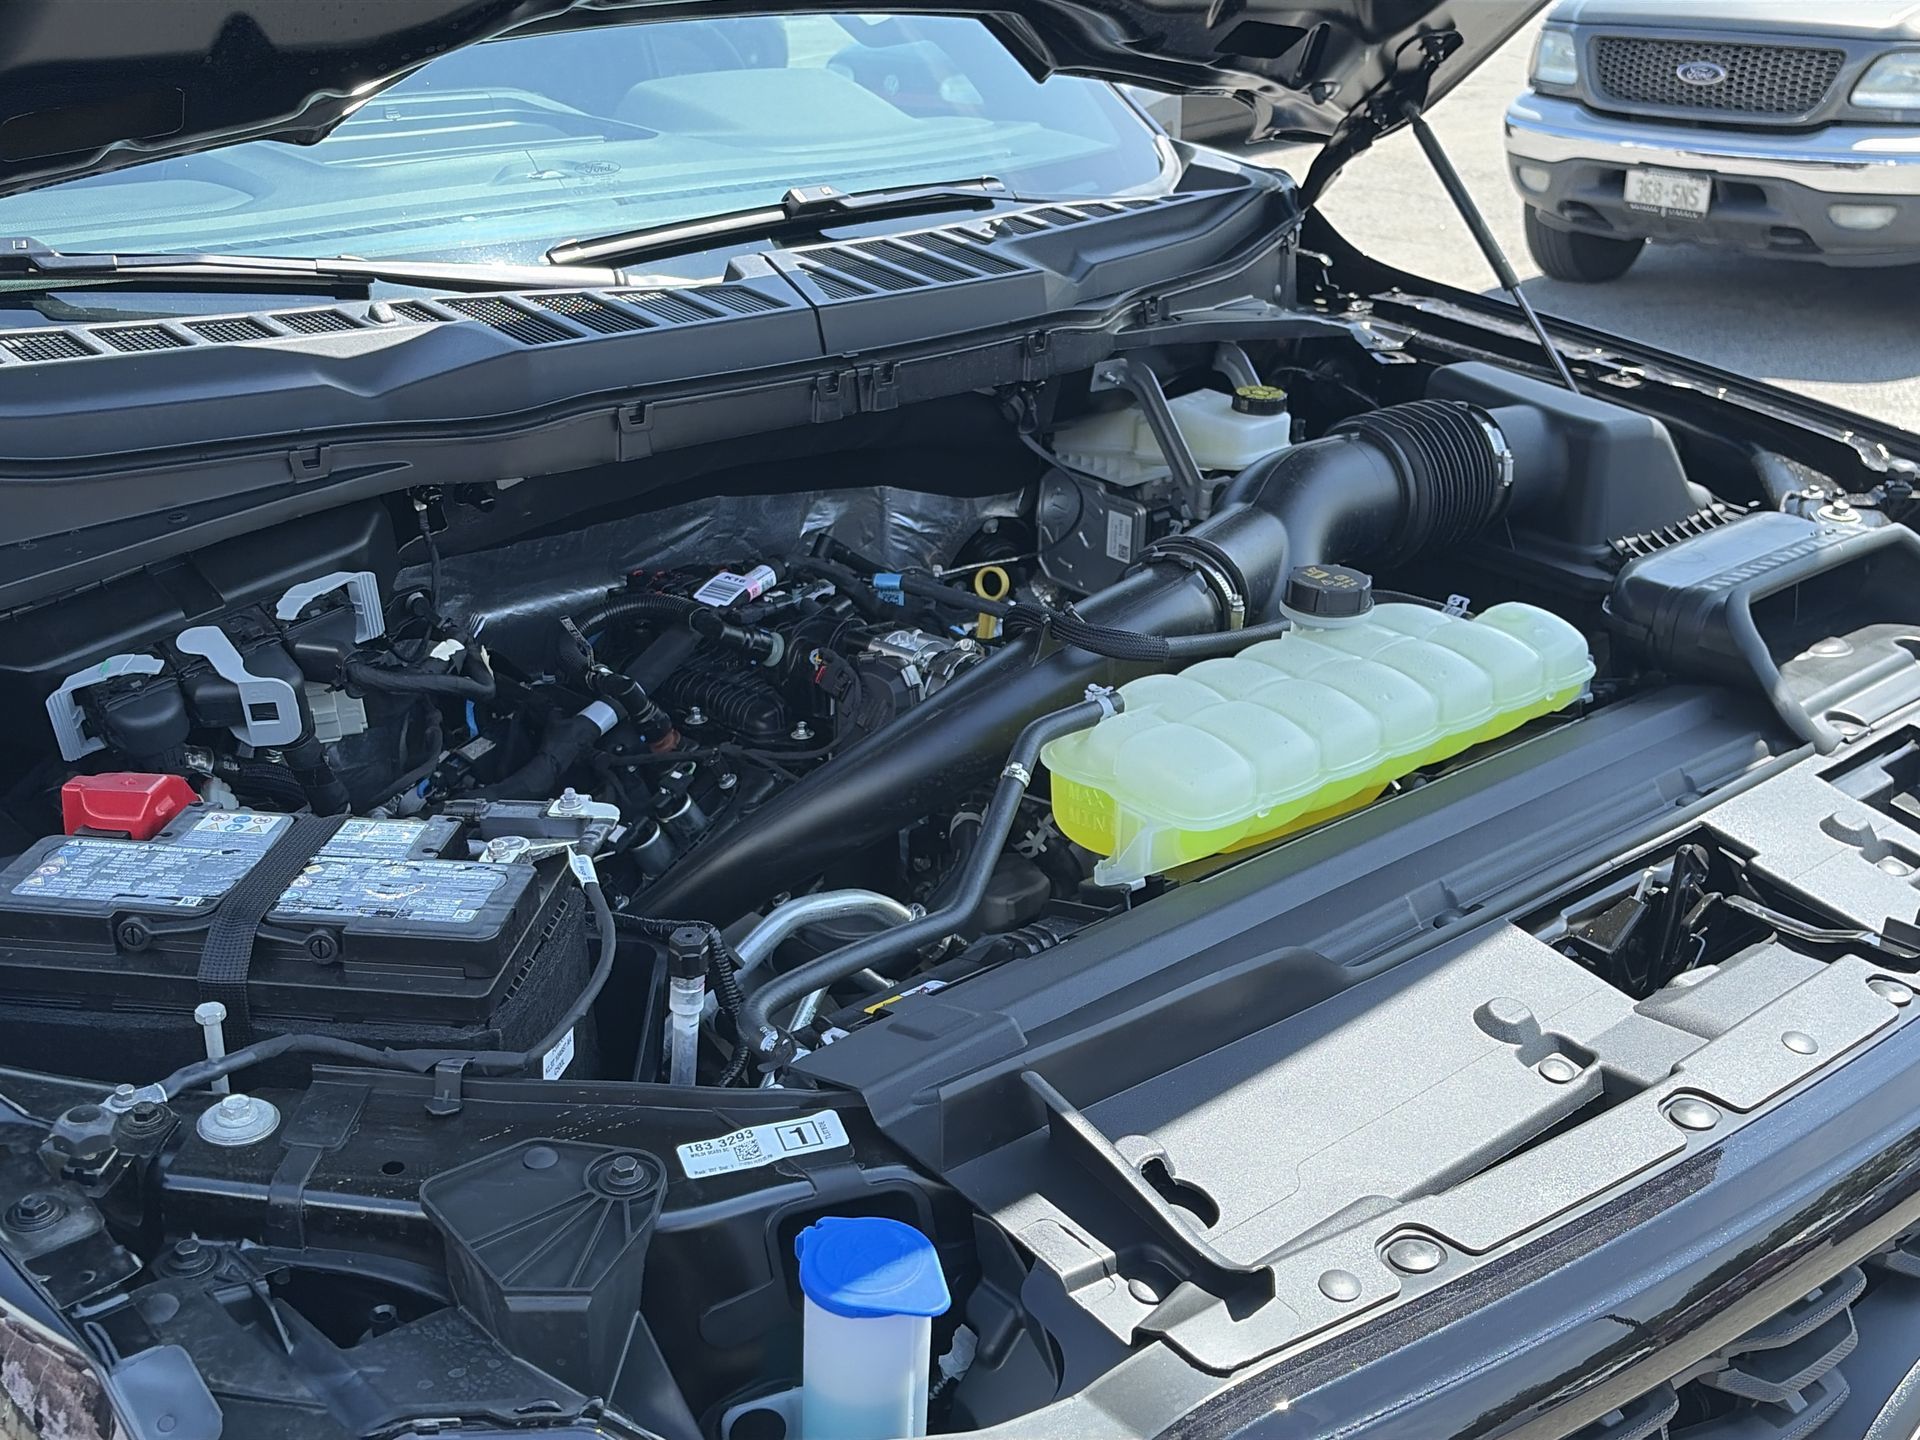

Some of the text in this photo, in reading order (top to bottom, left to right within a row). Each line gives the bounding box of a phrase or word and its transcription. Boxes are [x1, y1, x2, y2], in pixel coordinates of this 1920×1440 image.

[1068, 783, 1105, 808] MAX
[1068, 808, 1105, 832] MIN
[686, 1141, 713, 1154] 183
[717, 1129, 755, 1148] 3293
[789, 1127, 808, 1145] 1
